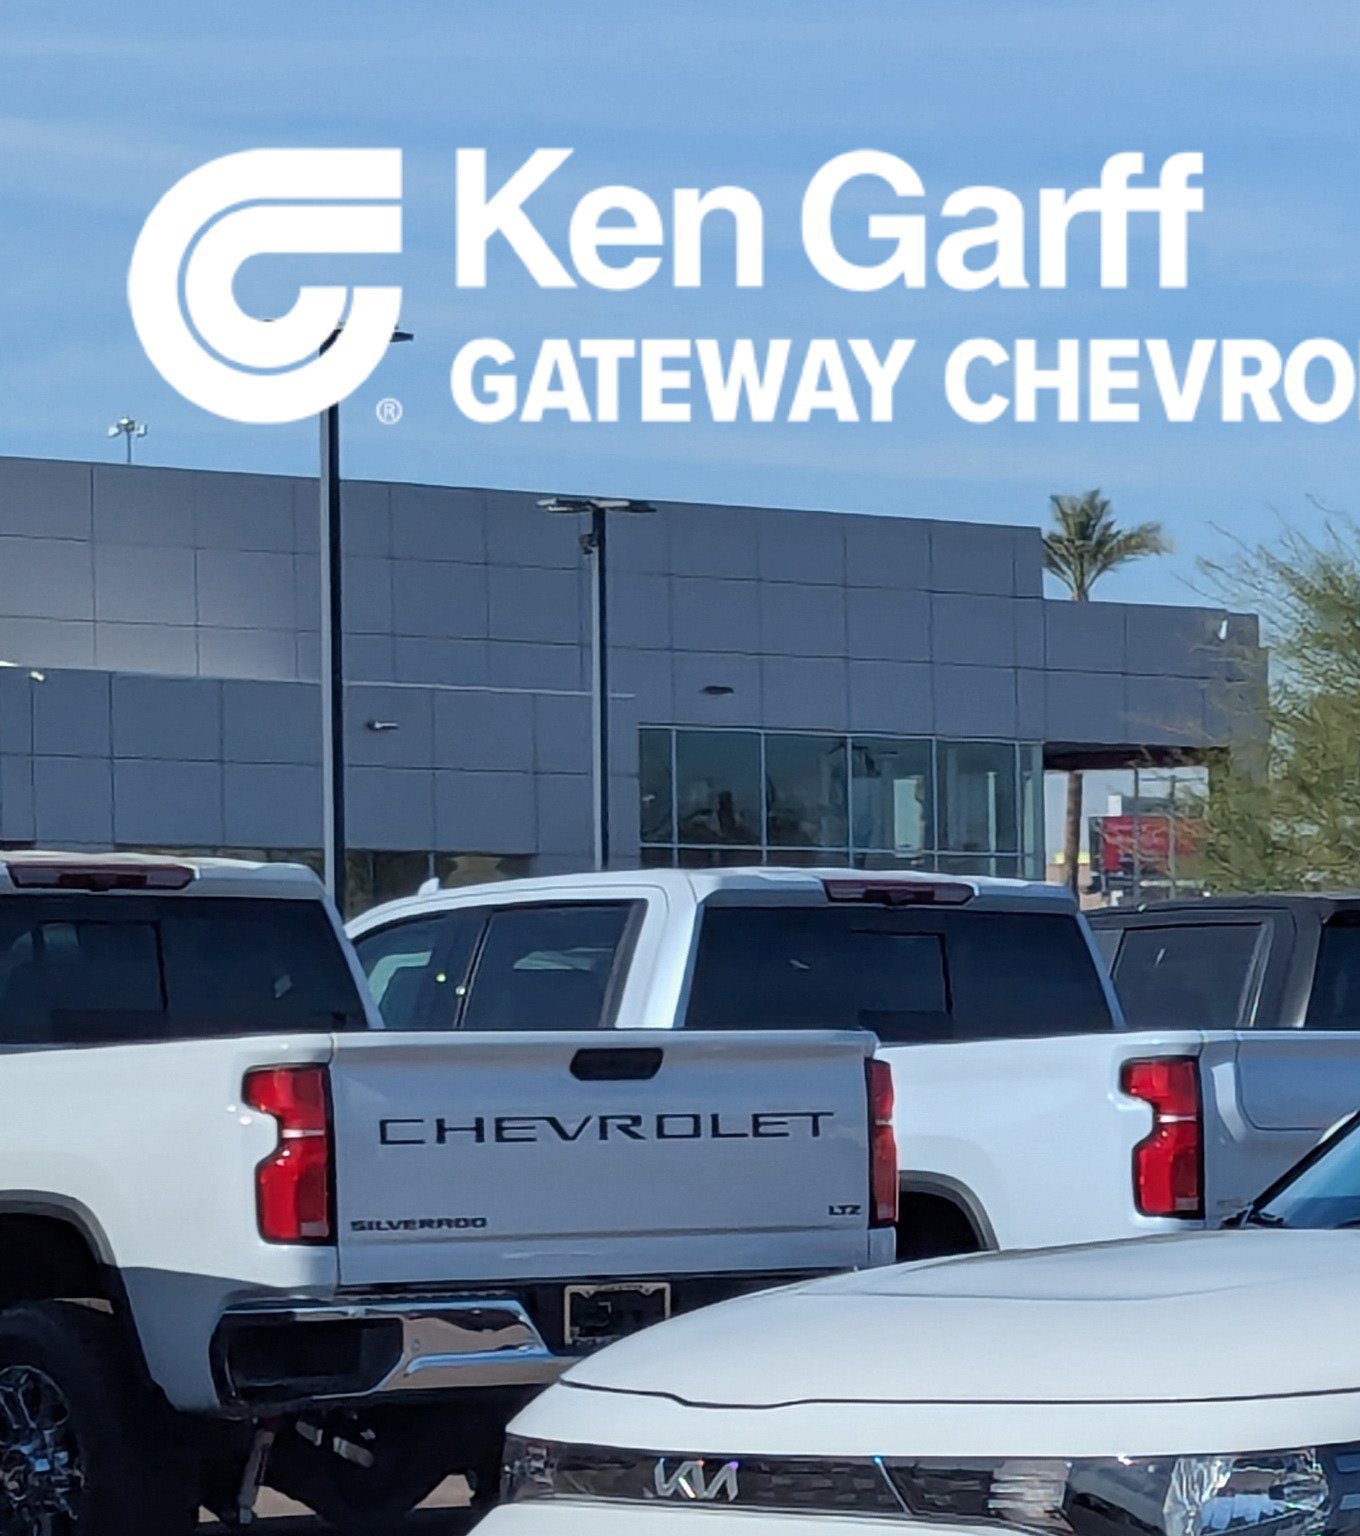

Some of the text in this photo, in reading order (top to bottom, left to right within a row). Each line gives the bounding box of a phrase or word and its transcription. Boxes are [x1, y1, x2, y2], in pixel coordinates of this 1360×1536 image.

[378, 1111, 834, 1146] CHEVROLET
[828, 1204, 861, 1216] LTZ
[350, 1217, 487, 1232] SILVERADO
